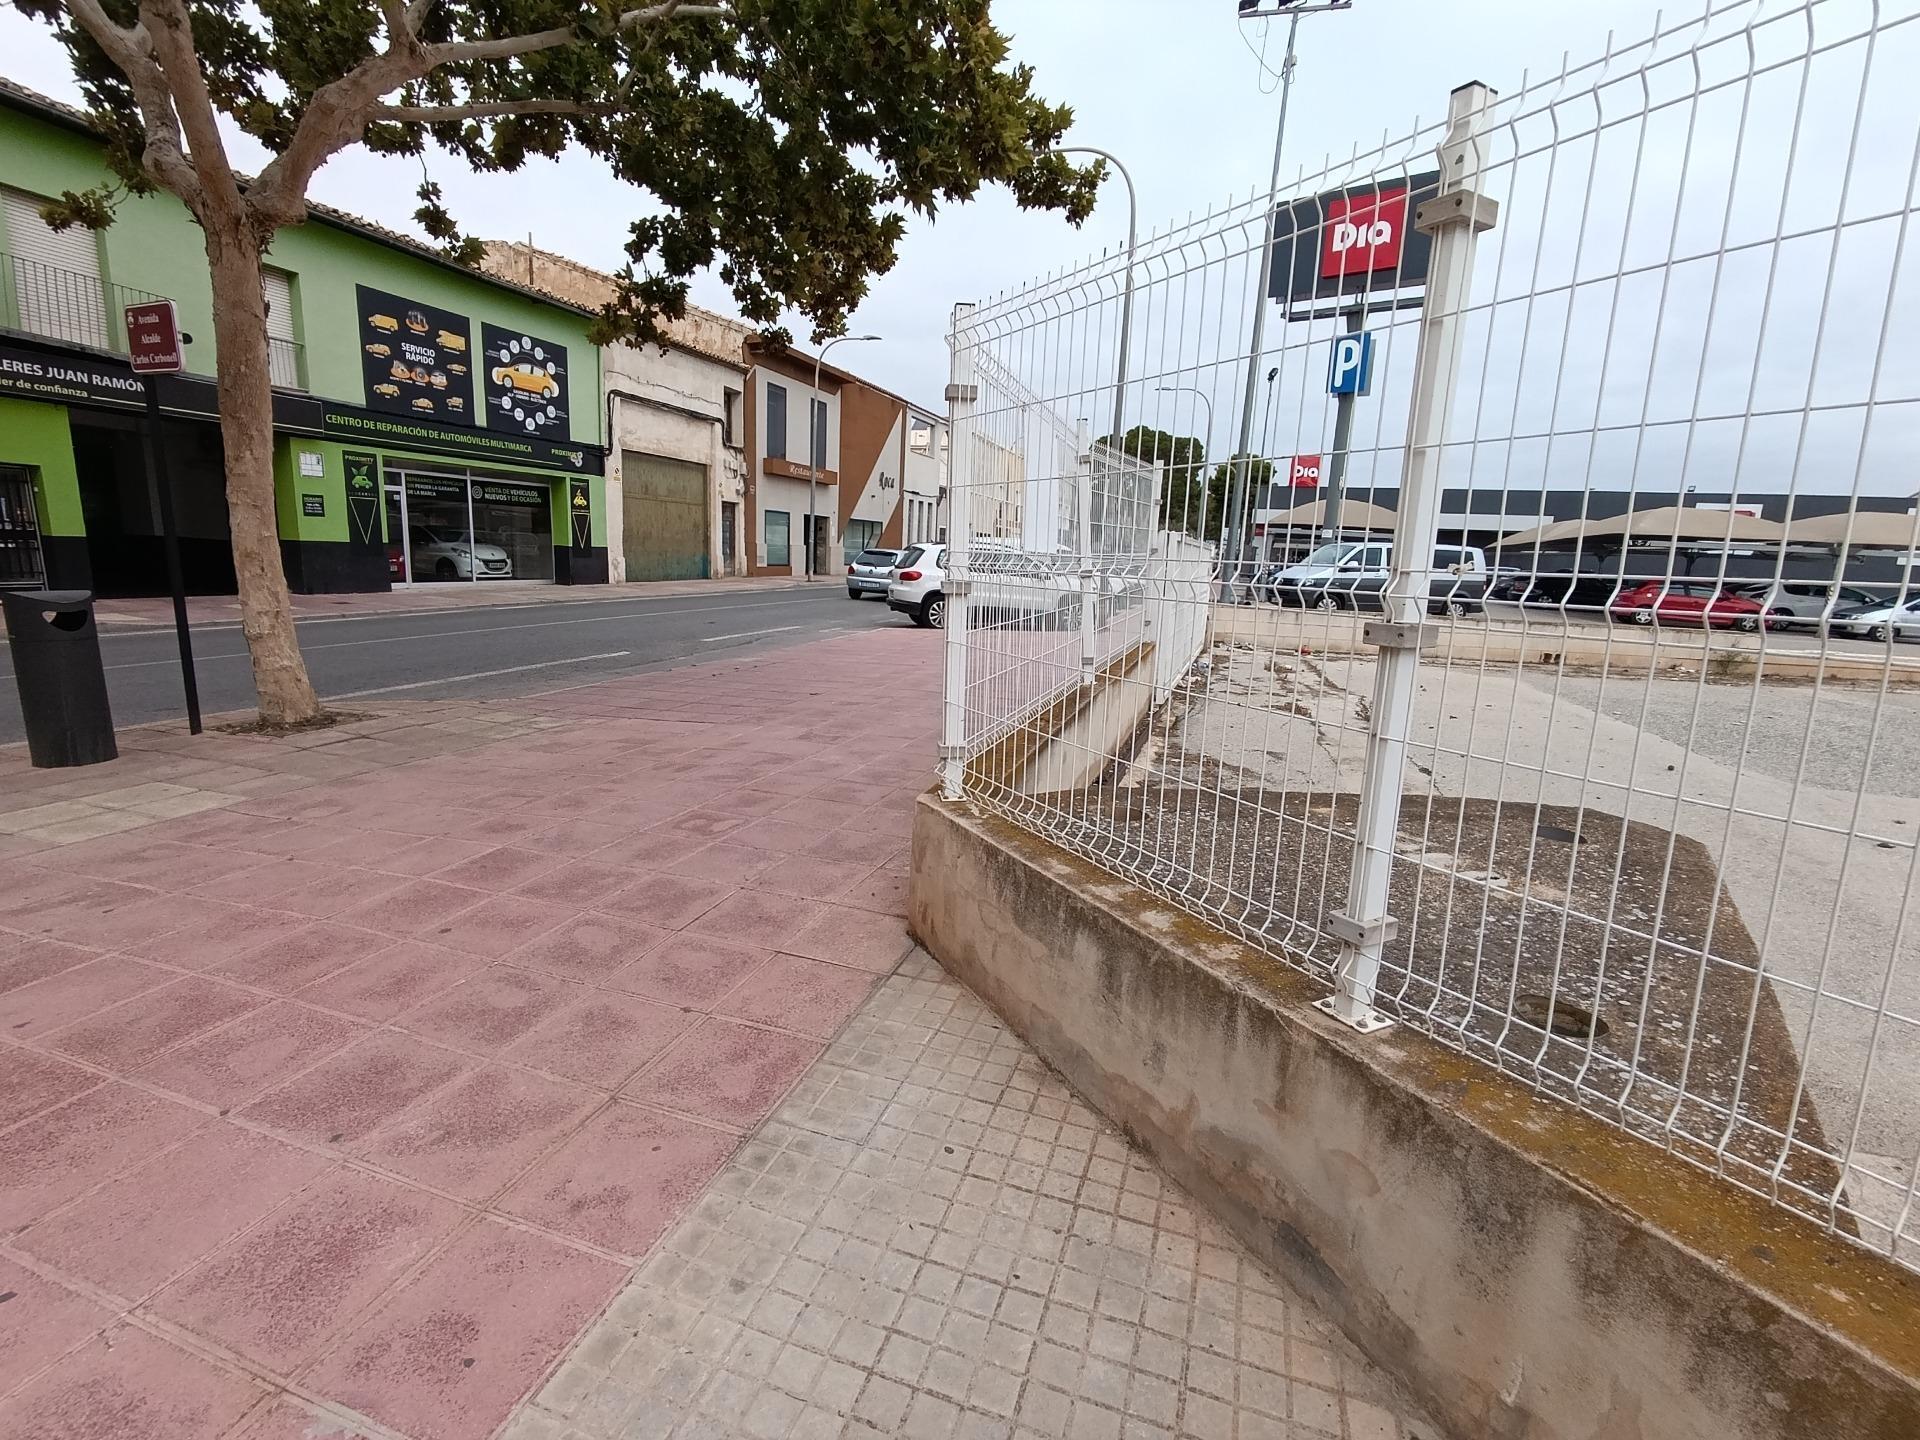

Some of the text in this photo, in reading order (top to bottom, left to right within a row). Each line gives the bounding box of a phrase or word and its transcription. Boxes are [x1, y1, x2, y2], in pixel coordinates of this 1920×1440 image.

[138, 313, 160, 324] Avenida
[141, 333, 161, 344] Alcalde
[401, 342, 436, 358] SERVICIO
[132, 352, 178, 364] Carlos Carbonell
[405, 351, 435, 365] RÁPIDO
[1334, 339, 1361, 388] P
[46, 366, 89, 384] JUAN
[16, 379, 32, 389] de
[34, 384, 88, 398] confianza
[325, 414, 533, 453] CENTRO DE REPARACIÓN DE AUTOMÓVILES MULTIMARCA
[789, 464, 825, 479] Restaurnte
[484, 493, 507, 501] NUEVOS
